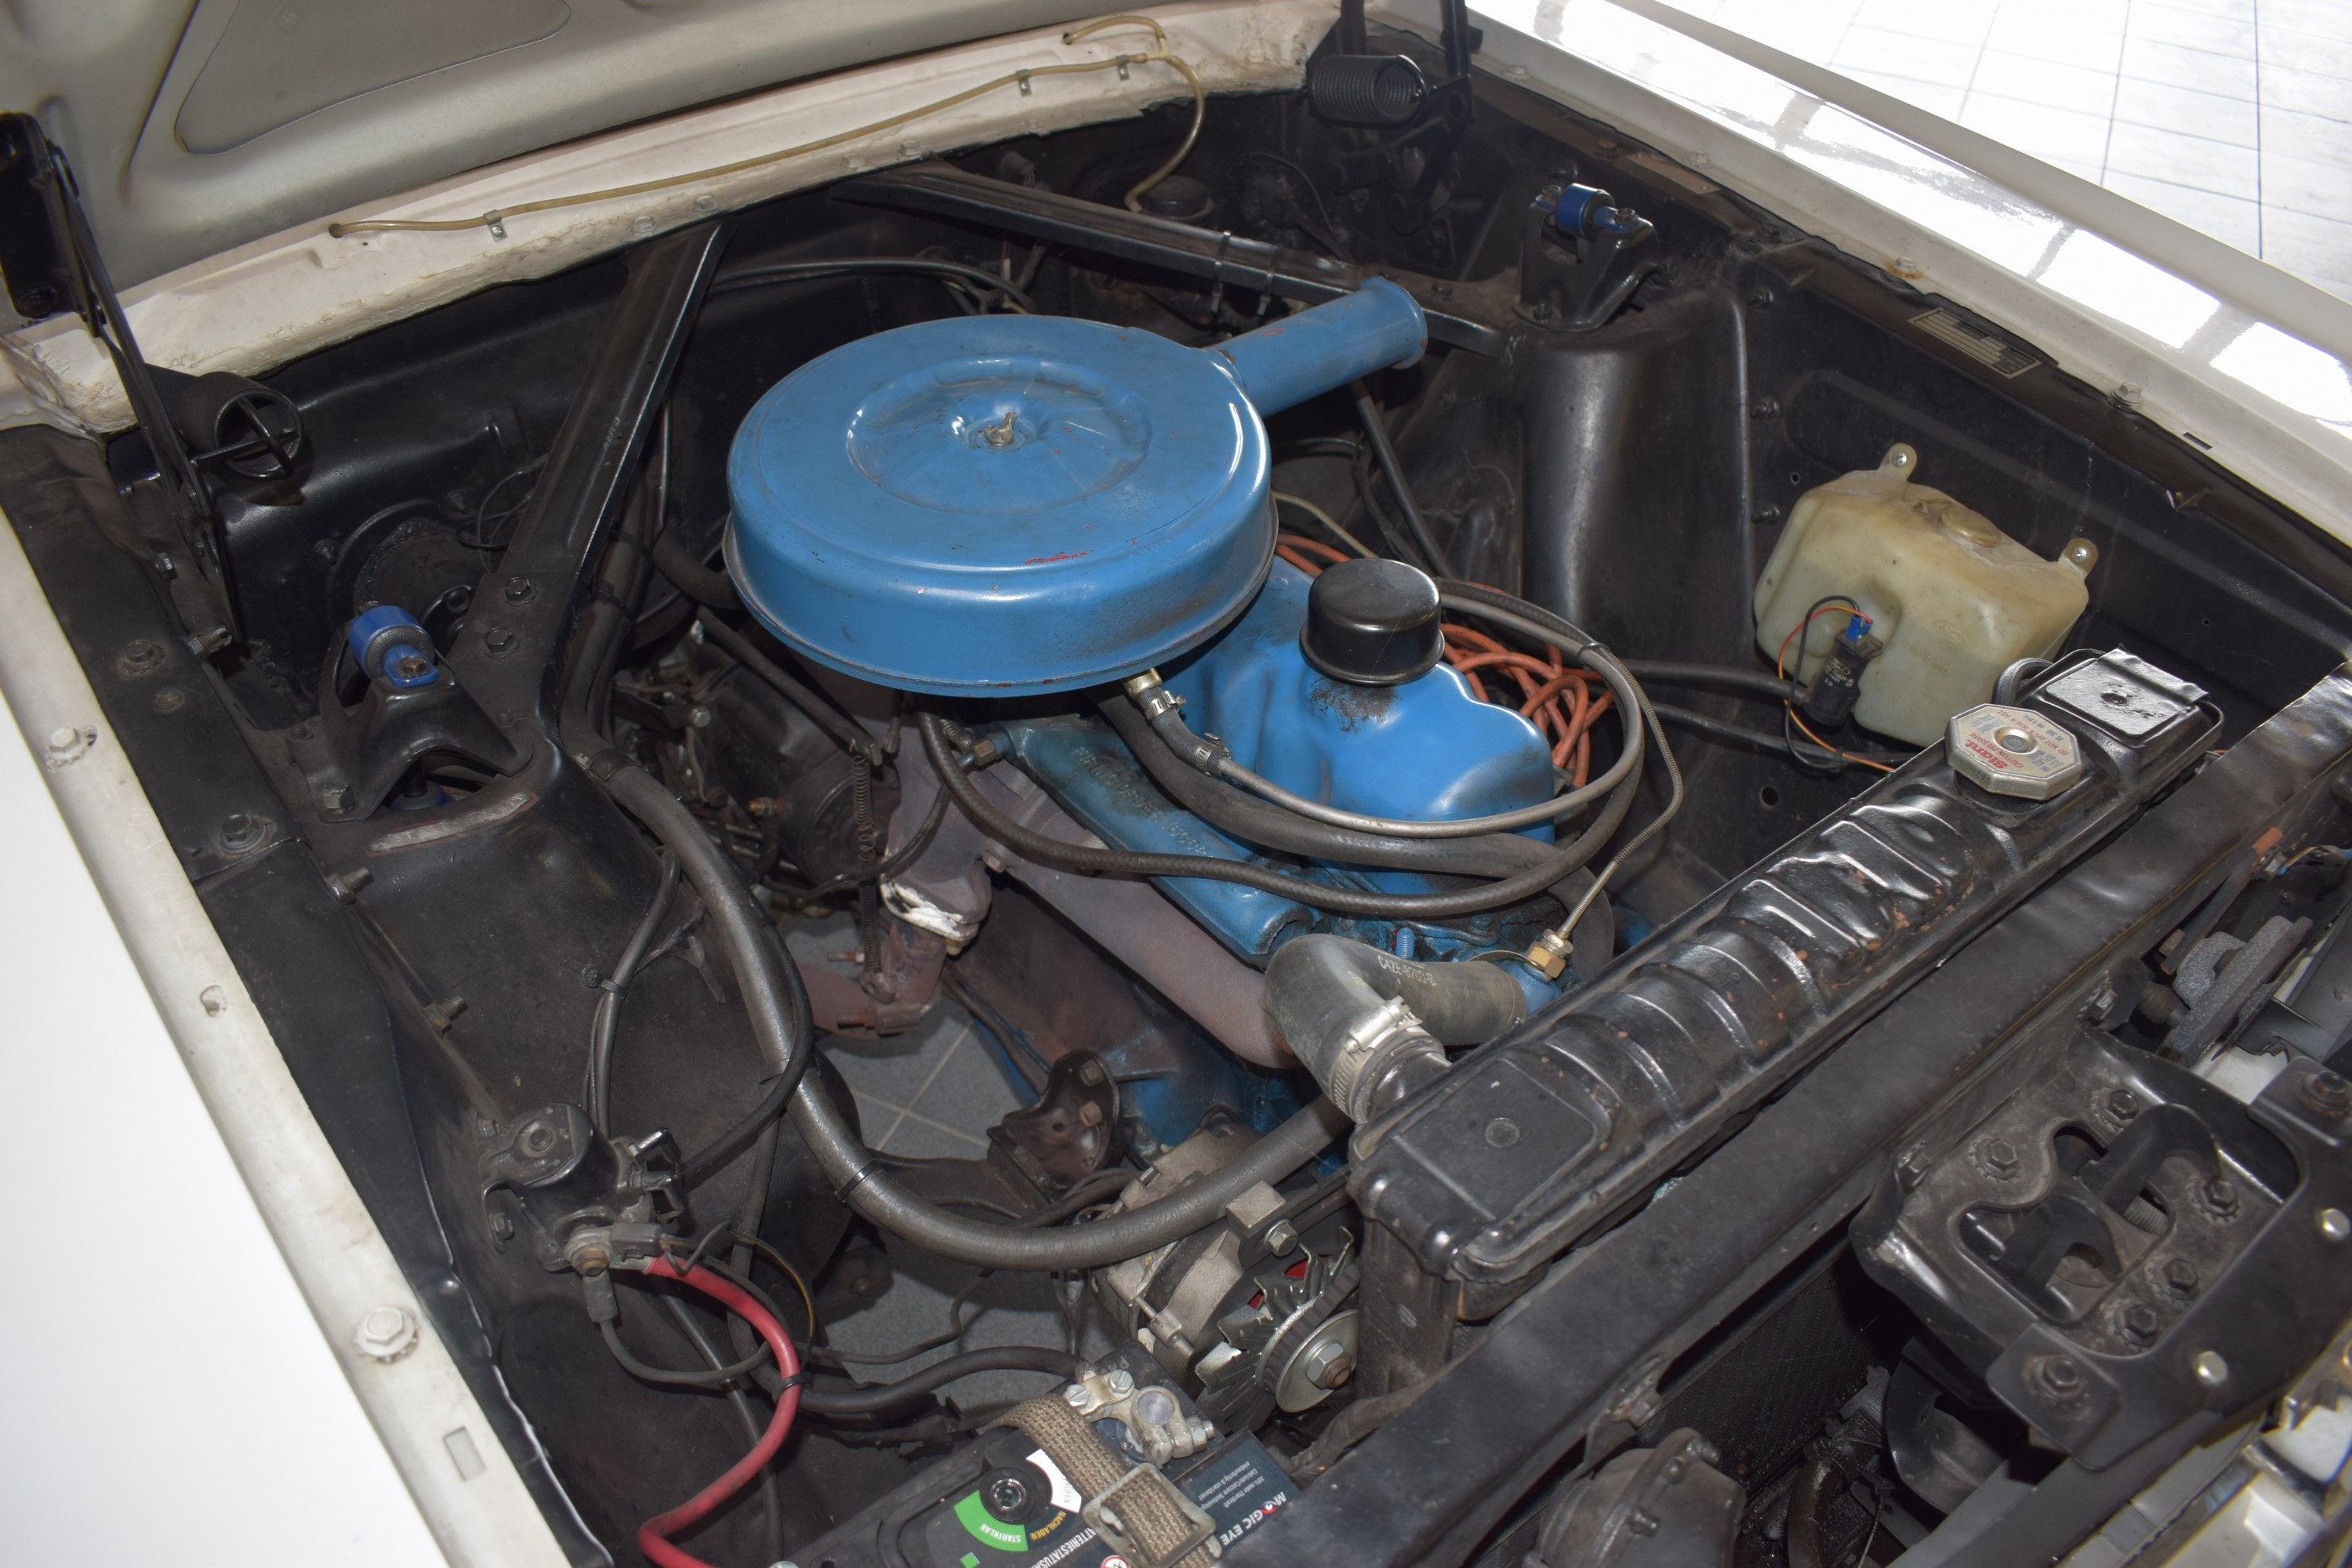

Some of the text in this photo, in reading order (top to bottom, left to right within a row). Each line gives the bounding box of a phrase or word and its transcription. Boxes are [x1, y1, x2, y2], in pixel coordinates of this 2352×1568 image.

[2010, 717, 2029, 731] WHEN
[1969, 732, 1998, 751] PRESSURE
[2029, 729, 2046, 741] OPEN
[2045, 739, 2059, 750] NOT
[1998, 749, 2024, 768] CAUTION
[1225, 1461, 1250, 1482] einbaufertig
[1199, 1482, 1221, 1501] startbereit
[1200, 1468, 1258, 1511] Calcium/Calcium Technologi
[1224, 1475, 1265, 1508] 30% mehr Startkraft
[981, 1523, 1021, 1543] STARTKLAR
[1029, 1511, 1066, 1541] NACHLADEN
[1220, 1524, 1243, 1546] EYE
